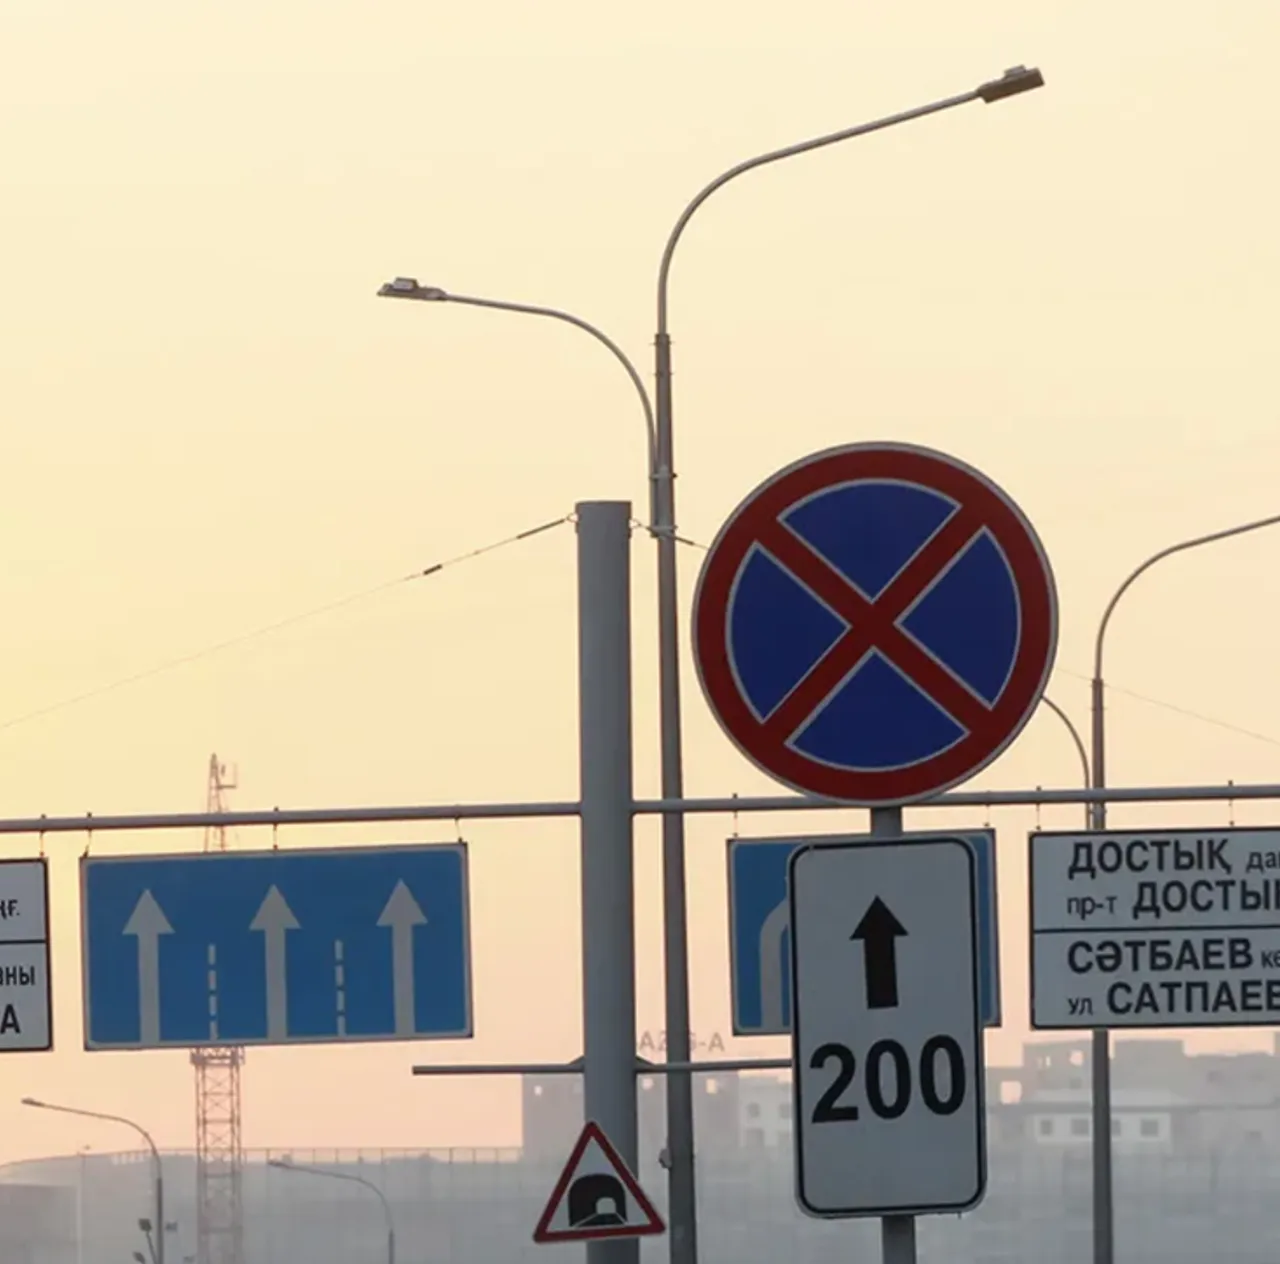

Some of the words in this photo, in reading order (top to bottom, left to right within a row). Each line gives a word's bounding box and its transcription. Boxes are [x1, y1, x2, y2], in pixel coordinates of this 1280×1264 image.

[1068, 839, 1231, 879] ДОСТЫҚ
[1246, 851, 1280, 874] да
[1067, 896, 1117, 920] пр-т
[1133, 879, 1280, 920] ДОСТЫ
[1068, 937, 1253, 974] СӘТБАЕВ
[1068, 997, 1093, 1016] ул
[810, 1034, 965, 1123] 200
